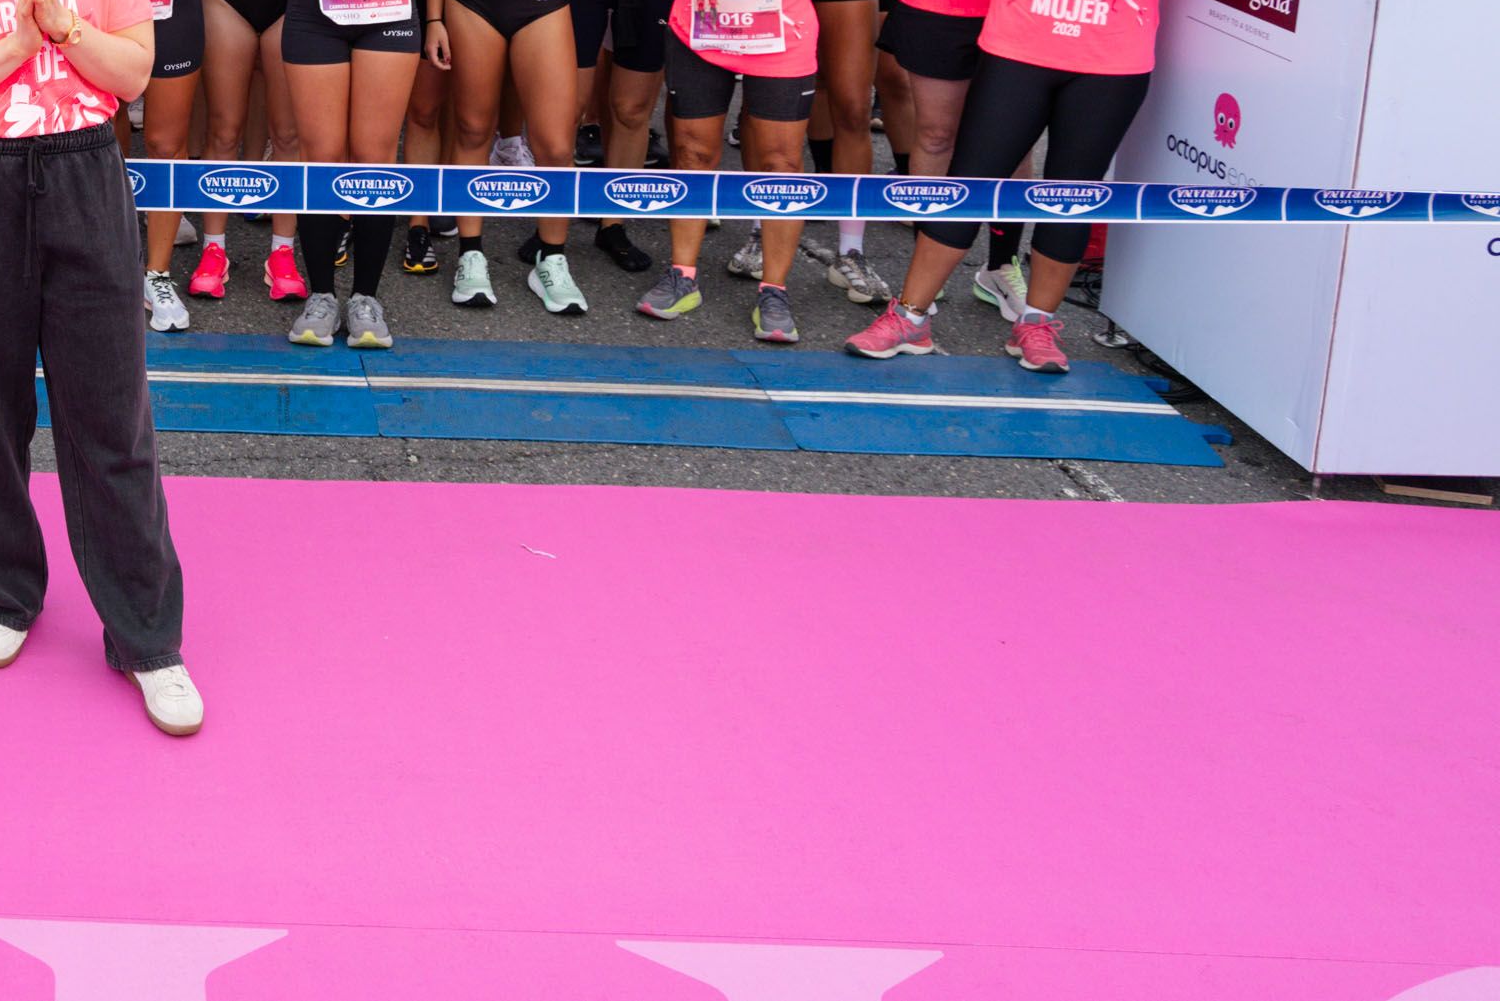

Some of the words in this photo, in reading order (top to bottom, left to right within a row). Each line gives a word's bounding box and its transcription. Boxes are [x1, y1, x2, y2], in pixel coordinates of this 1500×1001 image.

[719, 12, 754, 26] 016
[1052, 21, 1081, 37] 2026
[164, 60, 192, 71] OYSHO
[1166, 134, 1227, 180] octopus
[205, 177, 272, 193] ASTURIANA
[339, 179, 407, 194] ASTURIANA
[474, 181, 544, 197] ASTURIANA
[611, 182, 681, 198] ASTURIANA
[750, 184, 821, 200] ASTURIANA
[890, 185, 963, 200] ASTURIANA
[1033, 187, 1105, 202] ASTURIANA
[1177, 189, 1248, 203] ASTURIANA
